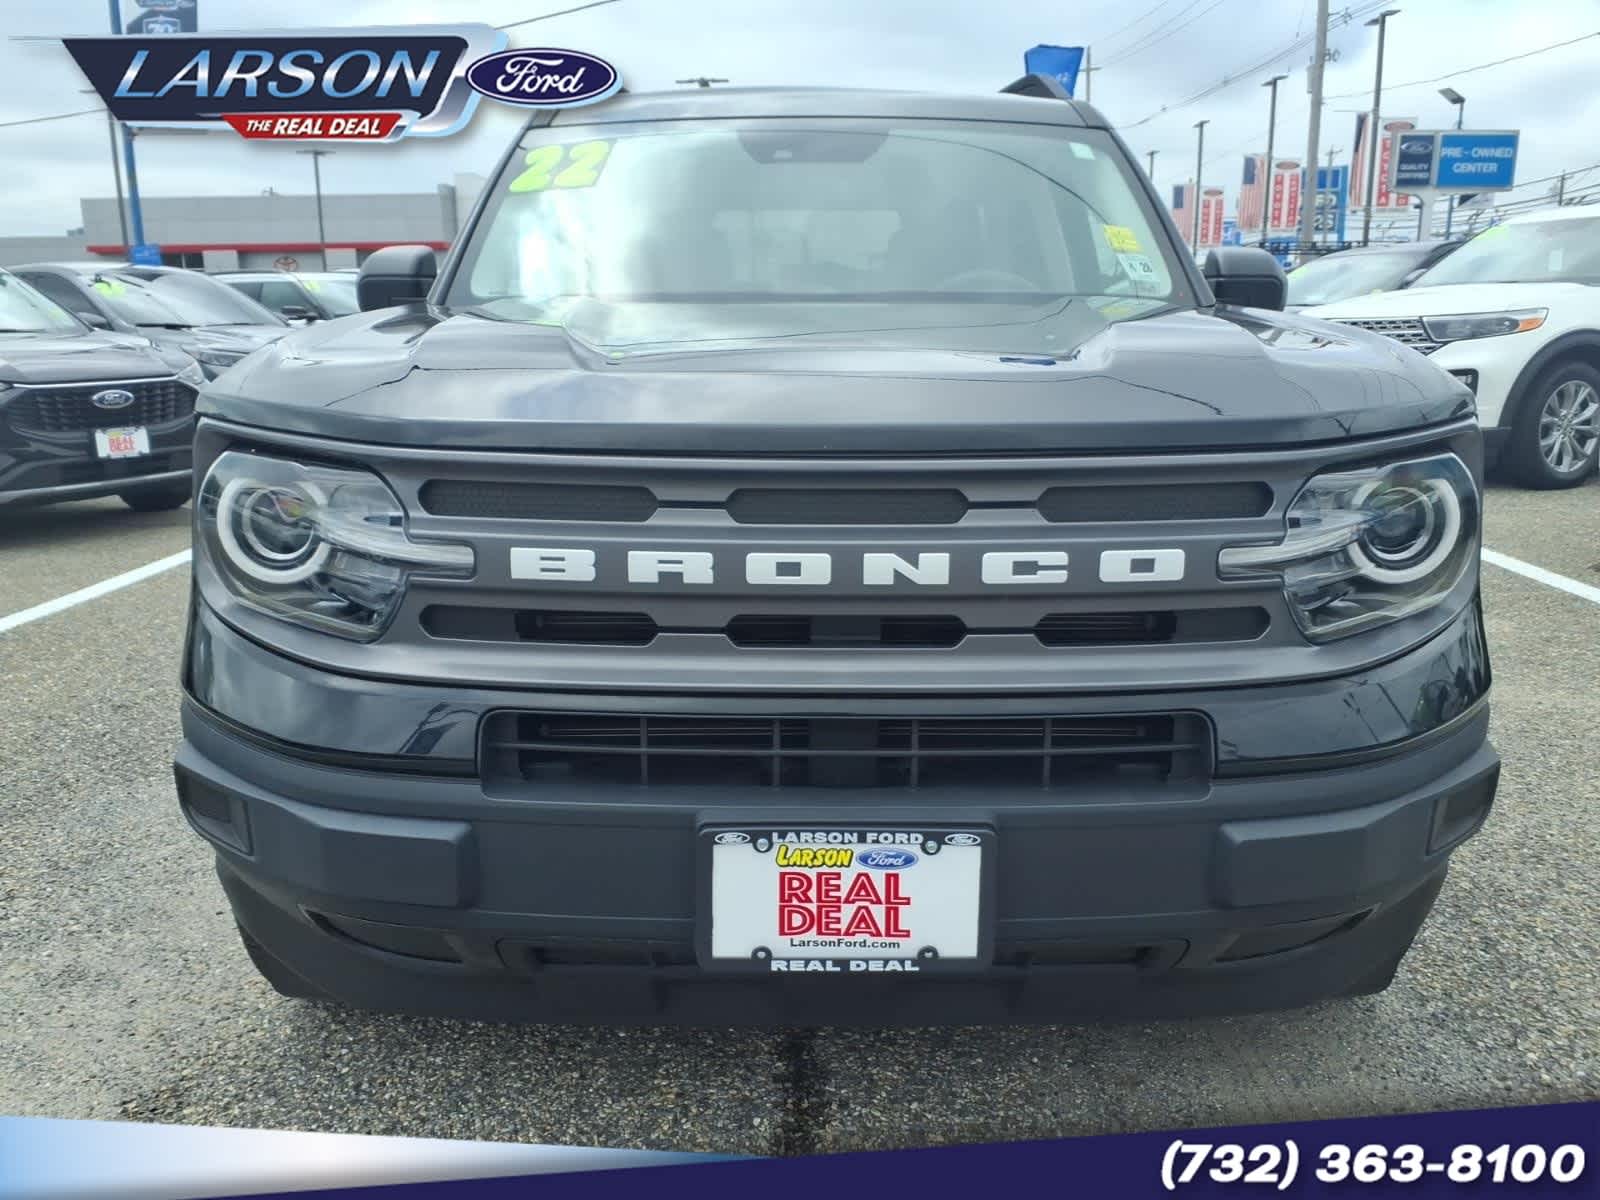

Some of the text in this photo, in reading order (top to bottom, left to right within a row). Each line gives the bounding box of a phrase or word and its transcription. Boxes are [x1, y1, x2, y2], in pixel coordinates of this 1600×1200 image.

[508, 140, 610, 193] 22
[1451, 162, 1498, 173] CENTER
[510, 546, 1186, 586] BRONCO
[771, 831, 924, 845] LARSON FORD
[778, 871, 912, 906] REAL
[778, 904, 912, 938] DEAL
[789, 937, 901, 950] LarsonFord.com
[770, 959, 920, 972] REAL DEAL
